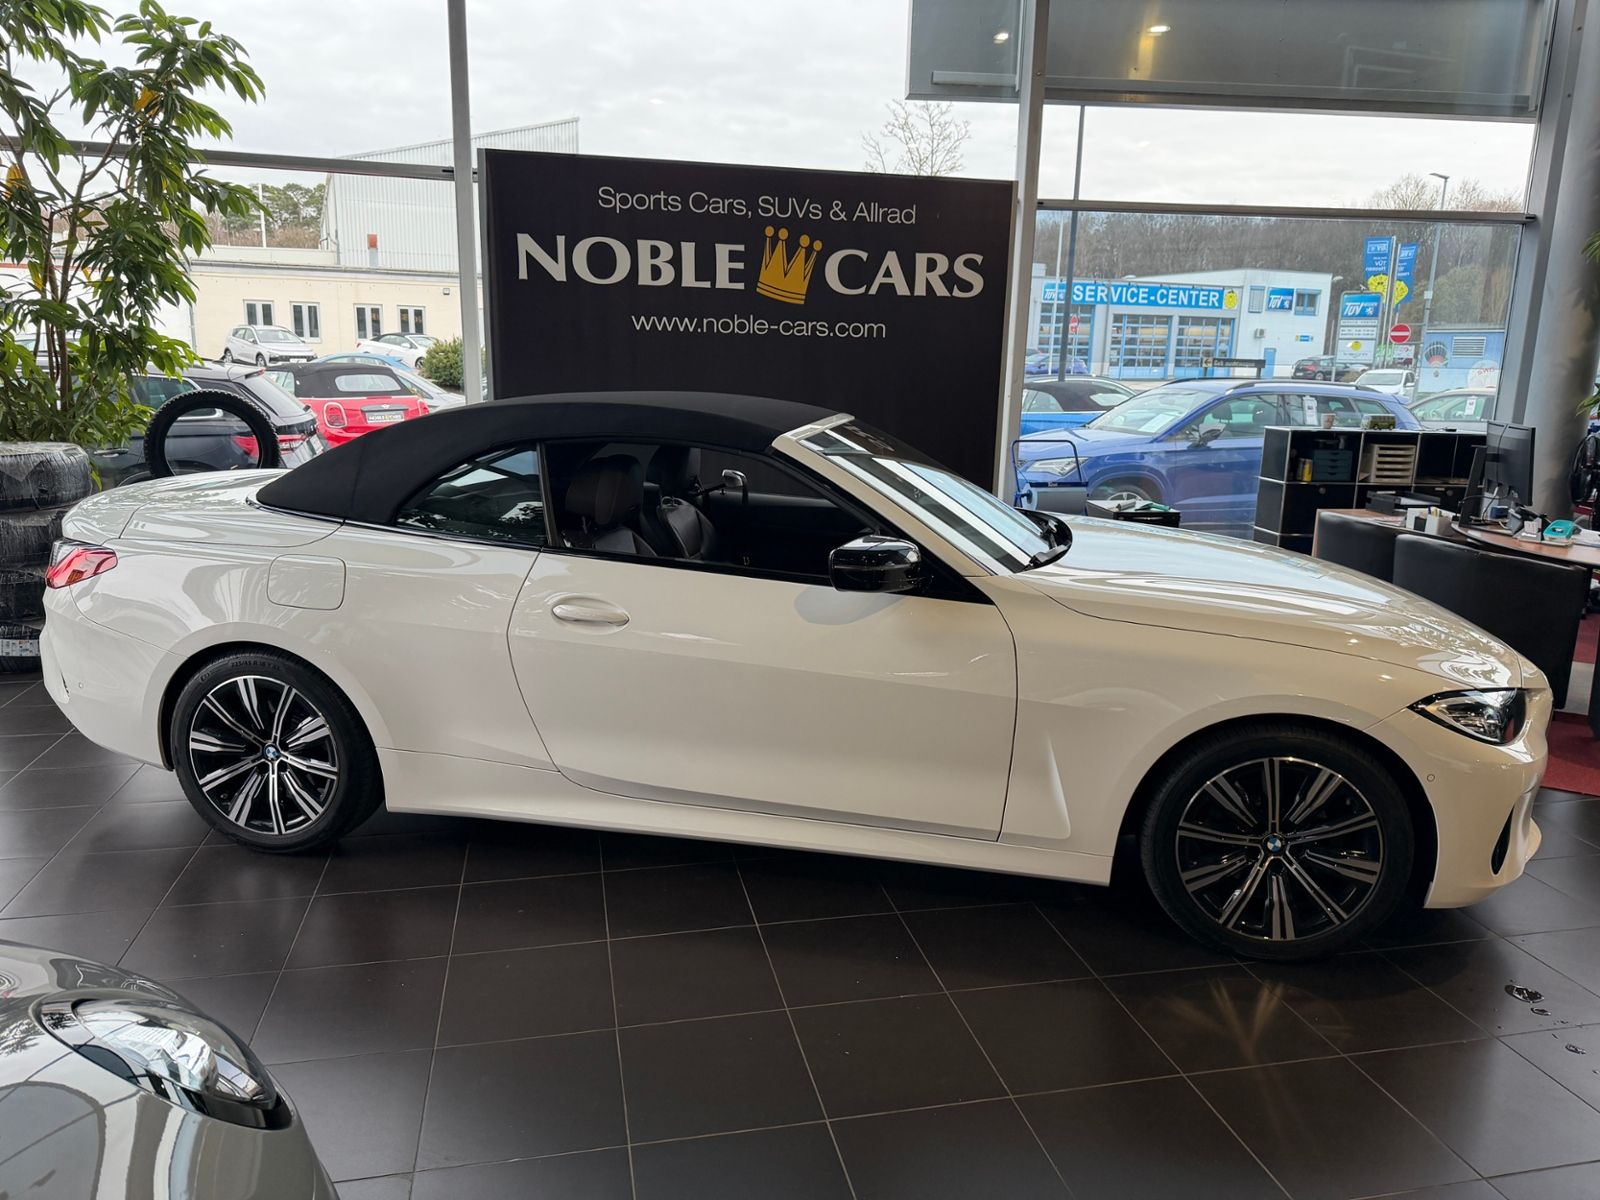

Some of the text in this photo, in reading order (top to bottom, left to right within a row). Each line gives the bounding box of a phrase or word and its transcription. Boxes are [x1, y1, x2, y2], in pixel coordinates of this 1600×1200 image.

[598, 186, 917, 225] Sports Cars, SUVs & Allrad
[516, 233, 984, 299] NOBLE CARS
[1072, 284, 1219, 307] SERVICE-CENTER
[1343, 302, 1364, 316] TÜV
[631, 314, 887, 339] www.noble-cars.com
